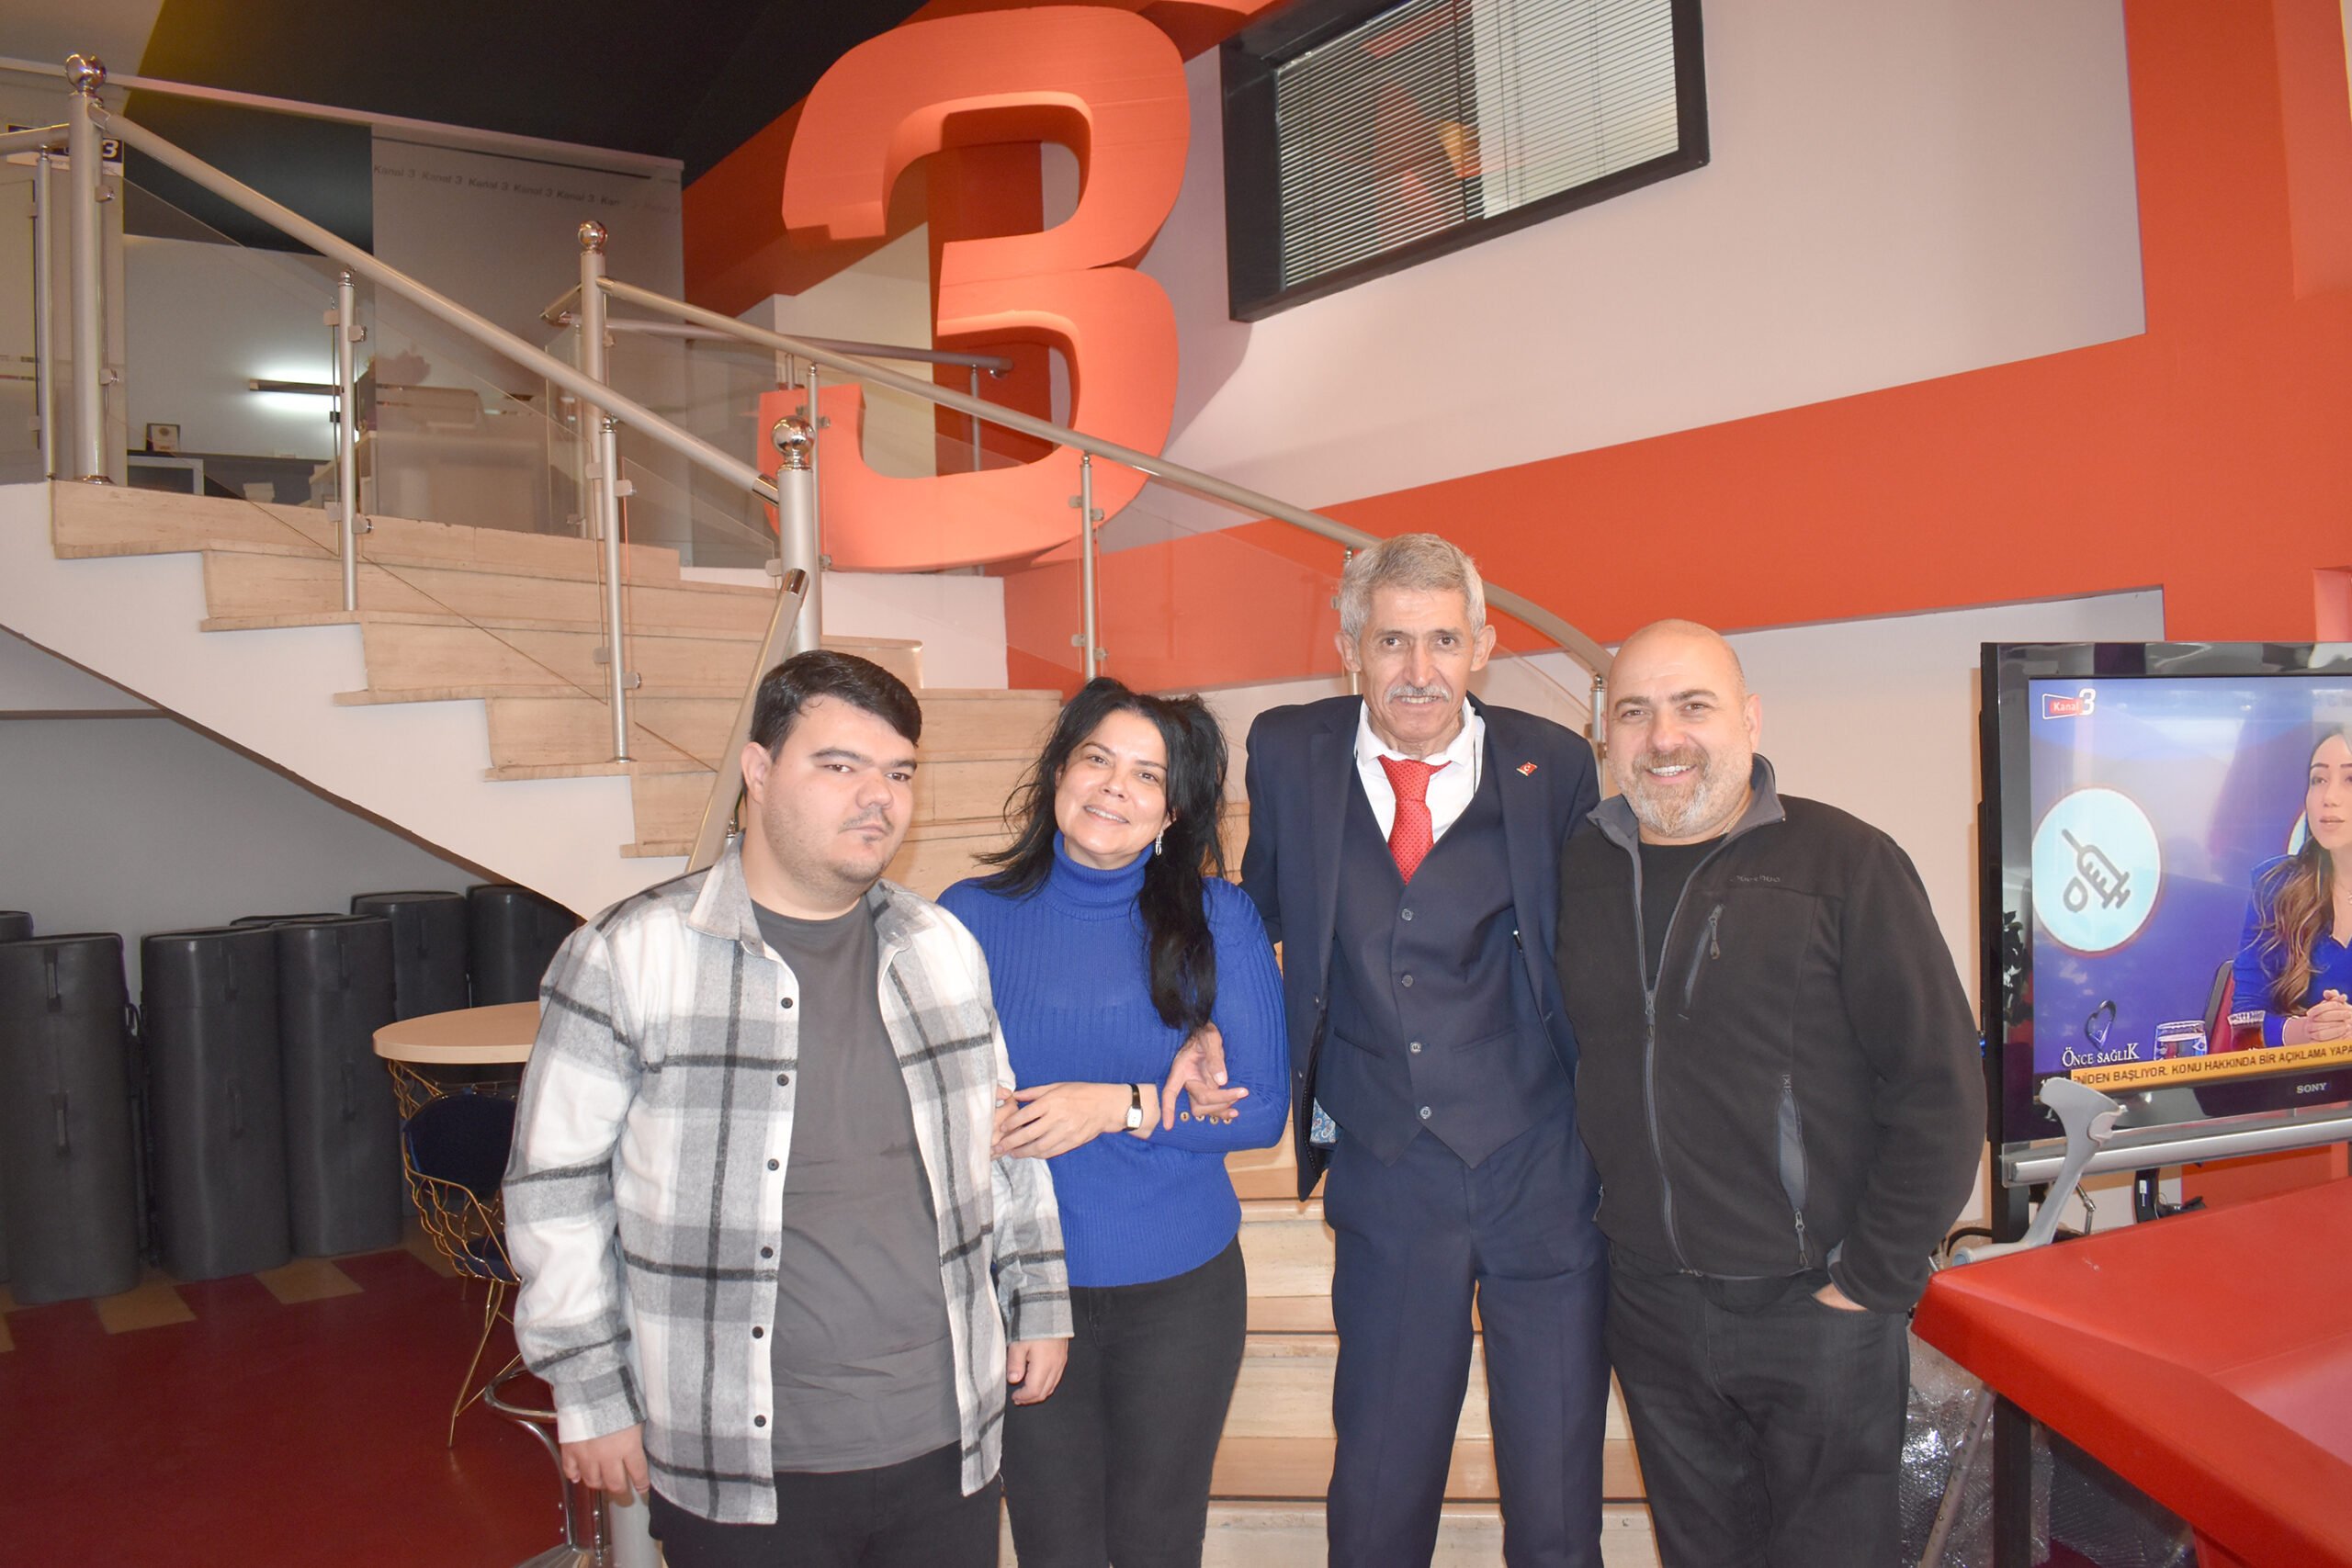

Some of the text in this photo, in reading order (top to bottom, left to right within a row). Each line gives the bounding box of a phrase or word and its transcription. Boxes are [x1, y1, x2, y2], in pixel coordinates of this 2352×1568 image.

[102, 139, 119, 158] 3
[374, 164, 404, 177] Kanal
[407, 168, 416, 178] 3
[422, 171, 452, 185] Kanal
[455, 175, 463, 185] 3
[469, 177, 498, 190] Kanal
[501, 182, 509, 191] 3
[514, 184, 543, 196] Kanal
[545, 187, 553, 197] 3
[557, 190, 585, 202] Kanal
[587, 194, 595, 203] 3
[756, 6, 1191, 573] 3
[2053, 688, 2097, 716] Kanal 3
[2062, 1043, 2140, 1067] ÖNCE SAĞLIK
[2113, 1066, 2167, 1082] BAŞLIYOR.
[2171, 1063, 2201, 1076] KONU
[2204, 1056, 2256, 1071] HAKKINDA
[2259, 1052, 2276, 1065] BİR
[2278, 1047, 2326, 1063] AÇIKLAMA
[2296, 1082, 2327, 1094] SONY
